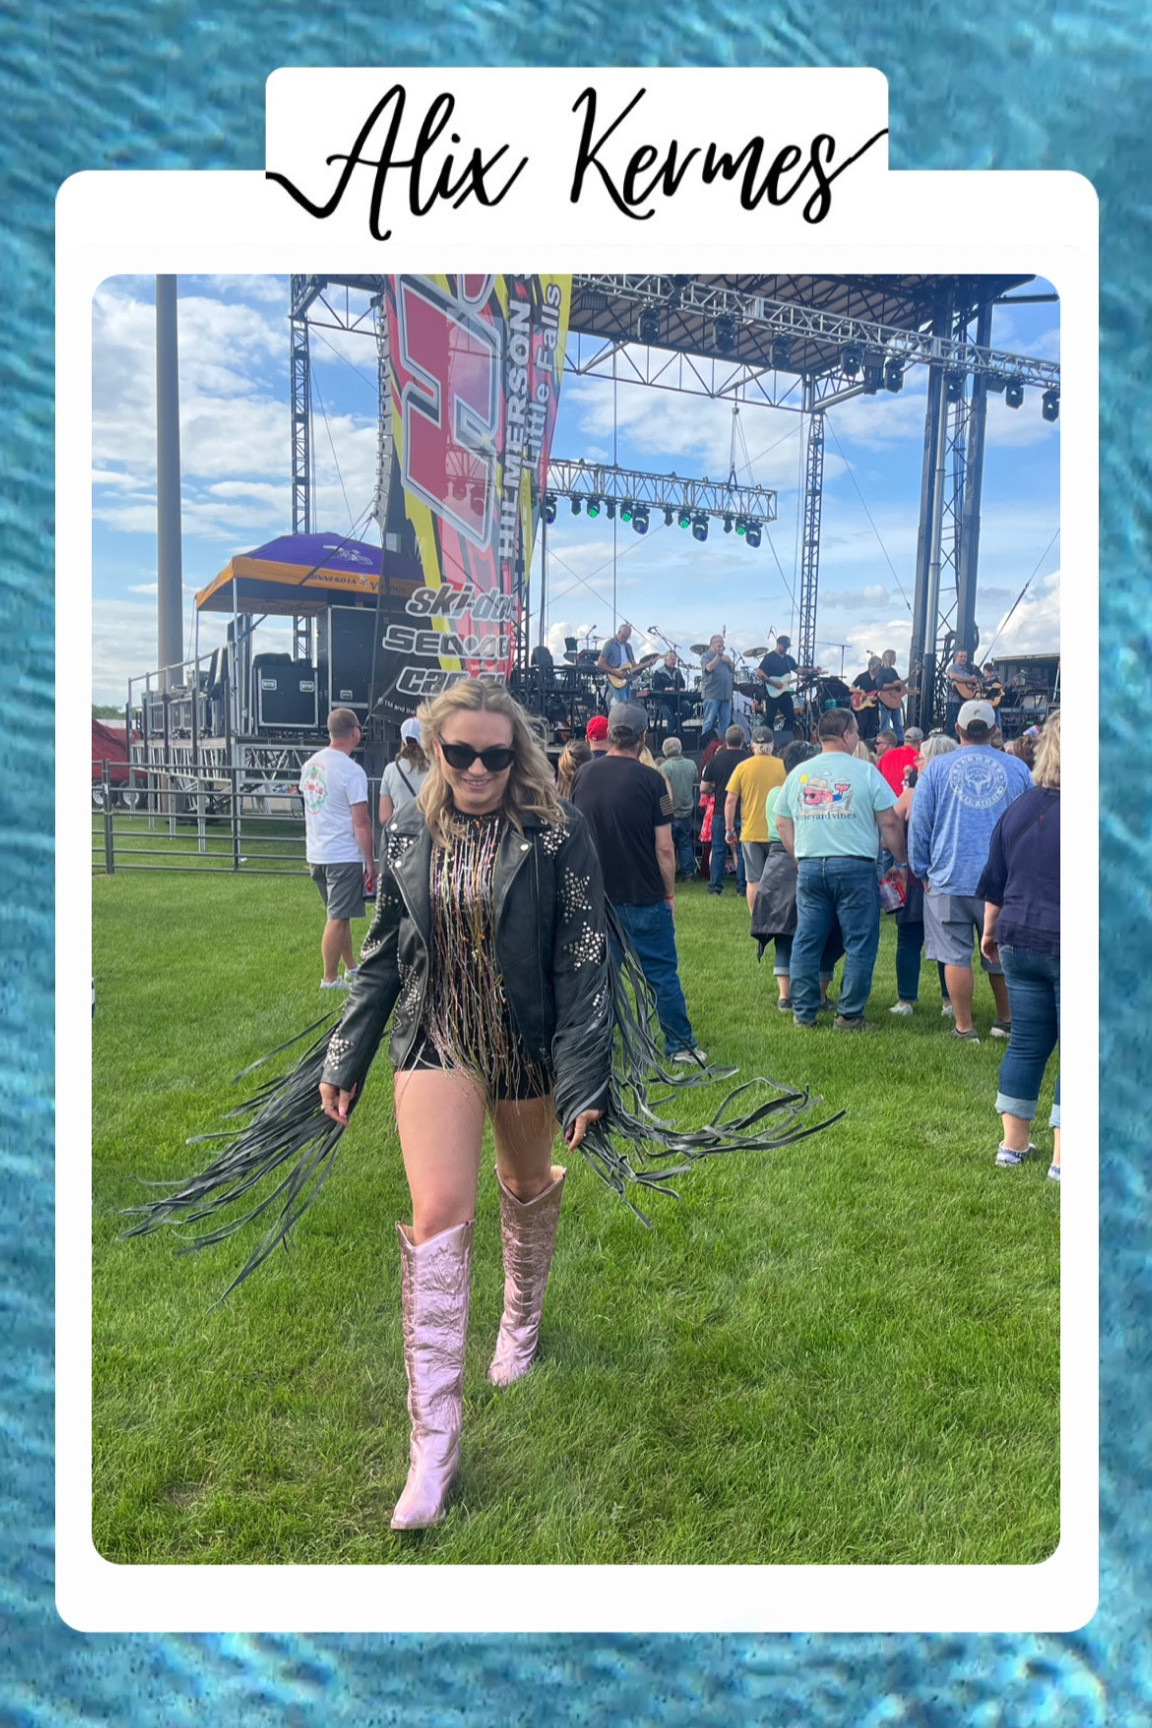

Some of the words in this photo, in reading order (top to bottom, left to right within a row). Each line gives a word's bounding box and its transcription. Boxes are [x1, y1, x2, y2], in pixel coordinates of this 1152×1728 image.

[498, 301, 531, 558] HILMERSON
[522, 382, 550, 470] Little
[536, 284, 562, 372] Falls
